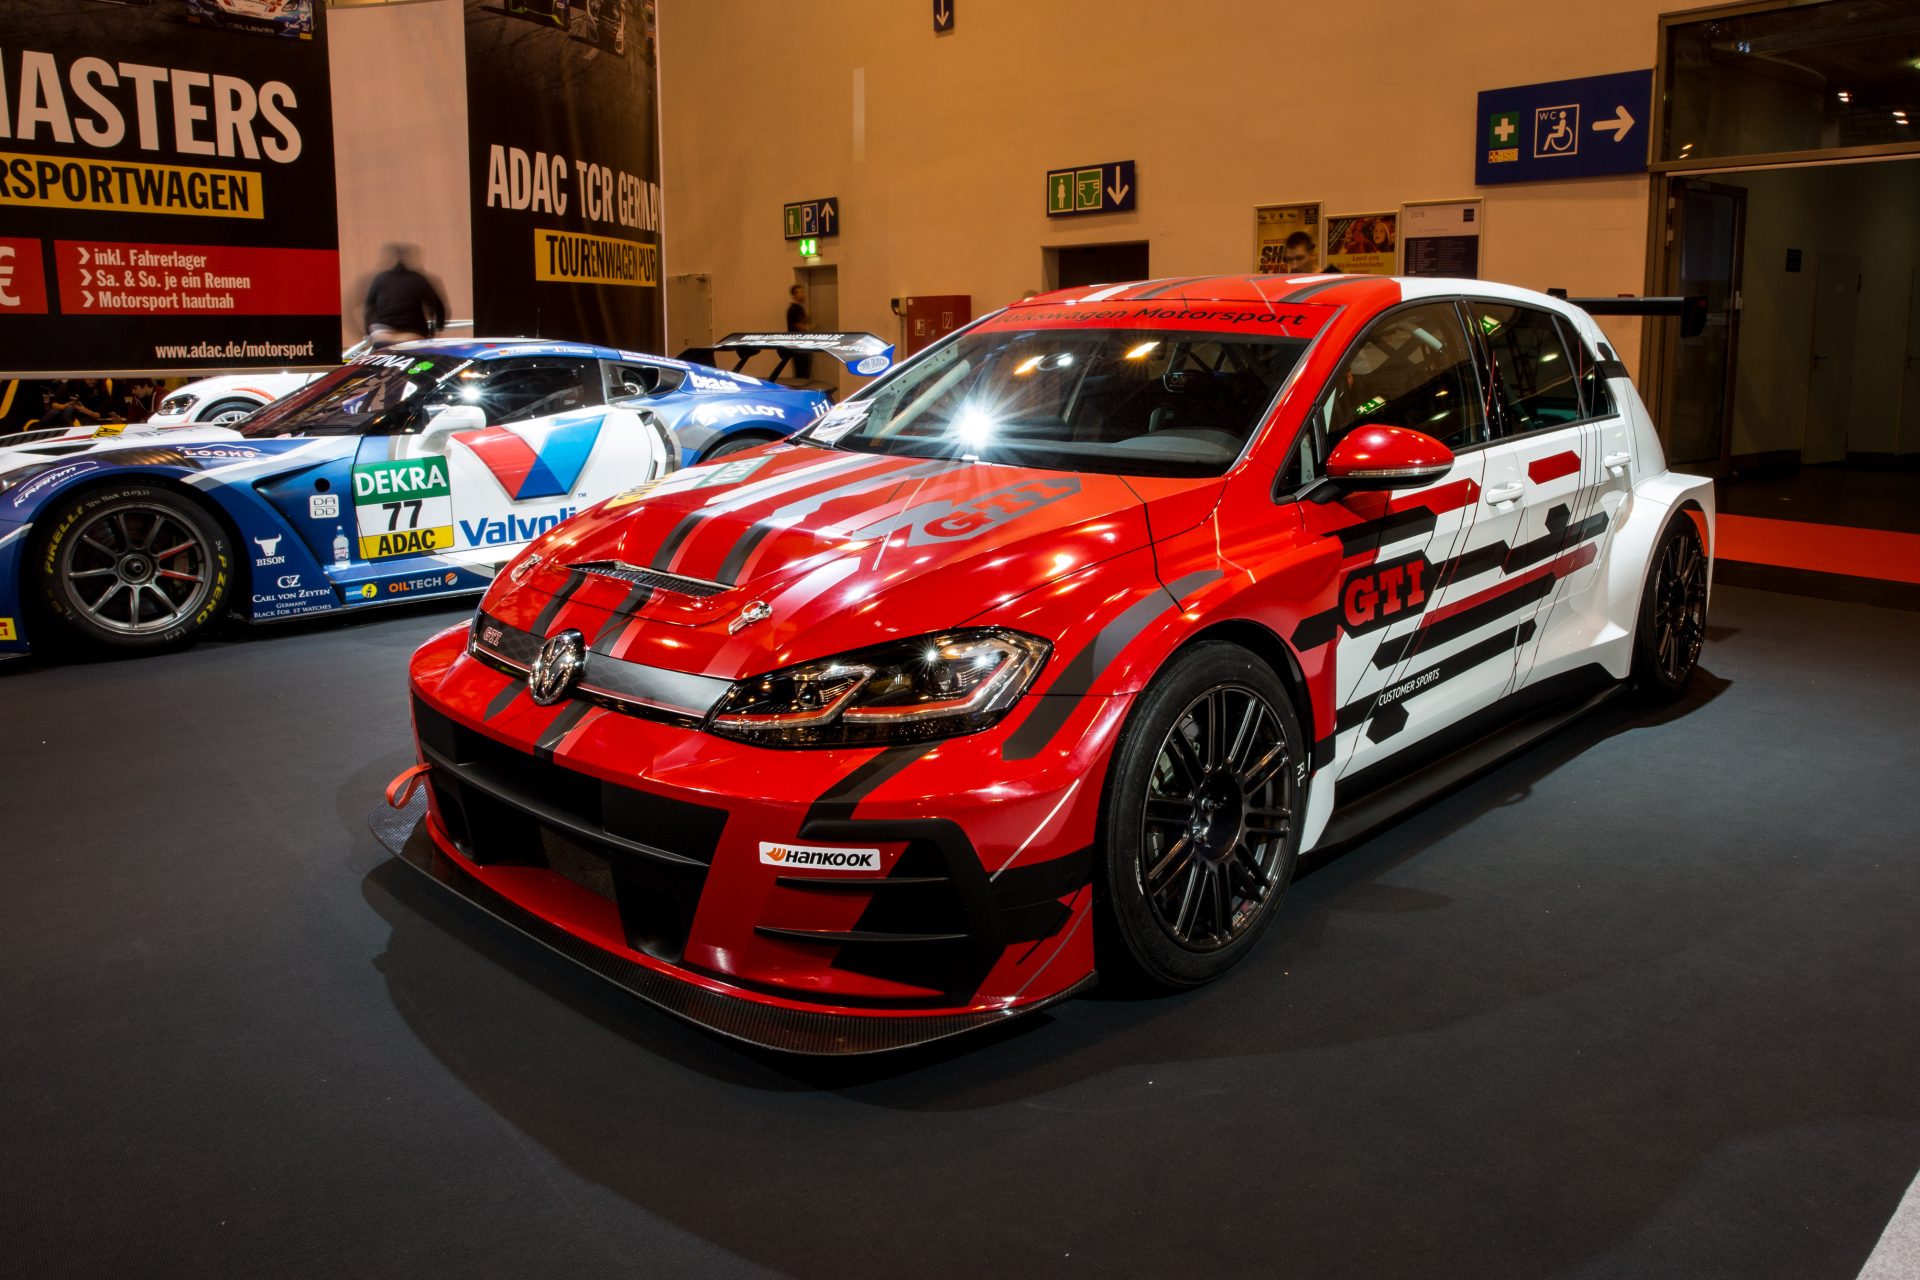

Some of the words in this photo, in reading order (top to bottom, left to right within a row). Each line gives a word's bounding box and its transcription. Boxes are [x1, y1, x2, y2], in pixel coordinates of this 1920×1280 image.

[0, 47, 302, 164] ASTERS
[1540, 111, 1557, 120] WC
[487, 144, 567, 216] ADAC
[575, 159, 614, 223] TCR
[94, 248, 126, 266] inkl.
[129, 249, 207, 270] Fahrerlager
[545, 235, 638, 281] TOURENWAGEN
[96, 270, 120, 287] Sa.
[124, 270, 136, 287] &
[138, 271, 161, 288] So.
[164, 271, 178, 291] je
[181, 272, 201, 288] ein
[204, 272, 251, 289] Rennen
[98, 291, 179, 311] Motorsport
[182, 292, 235, 309] hautnah
[997, 308, 1127, 324] Volkswagen
[1132, 307, 1308, 326] Motorsport
[155, 341, 314, 360] www.adac.de/motorsport
[725, 405, 786, 419] PILOT
[354, 464, 447, 497] DEKRA
[382, 500, 423, 531] 77
[924, 482, 1074, 538] GTI
[44, 505, 84, 575] PIRELLI
[378, 530, 436, 556] ADAC
[256, 556, 286, 567] BISON
[196, 571, 227, 625] ZERO
[388, 577, 442, 593] OILTECH
[1343, 559, 1425, 627] GTI
[1378, 680, 1416, 706] CUSTOMER
[1415, 668, 1440, 689] SPORTS
